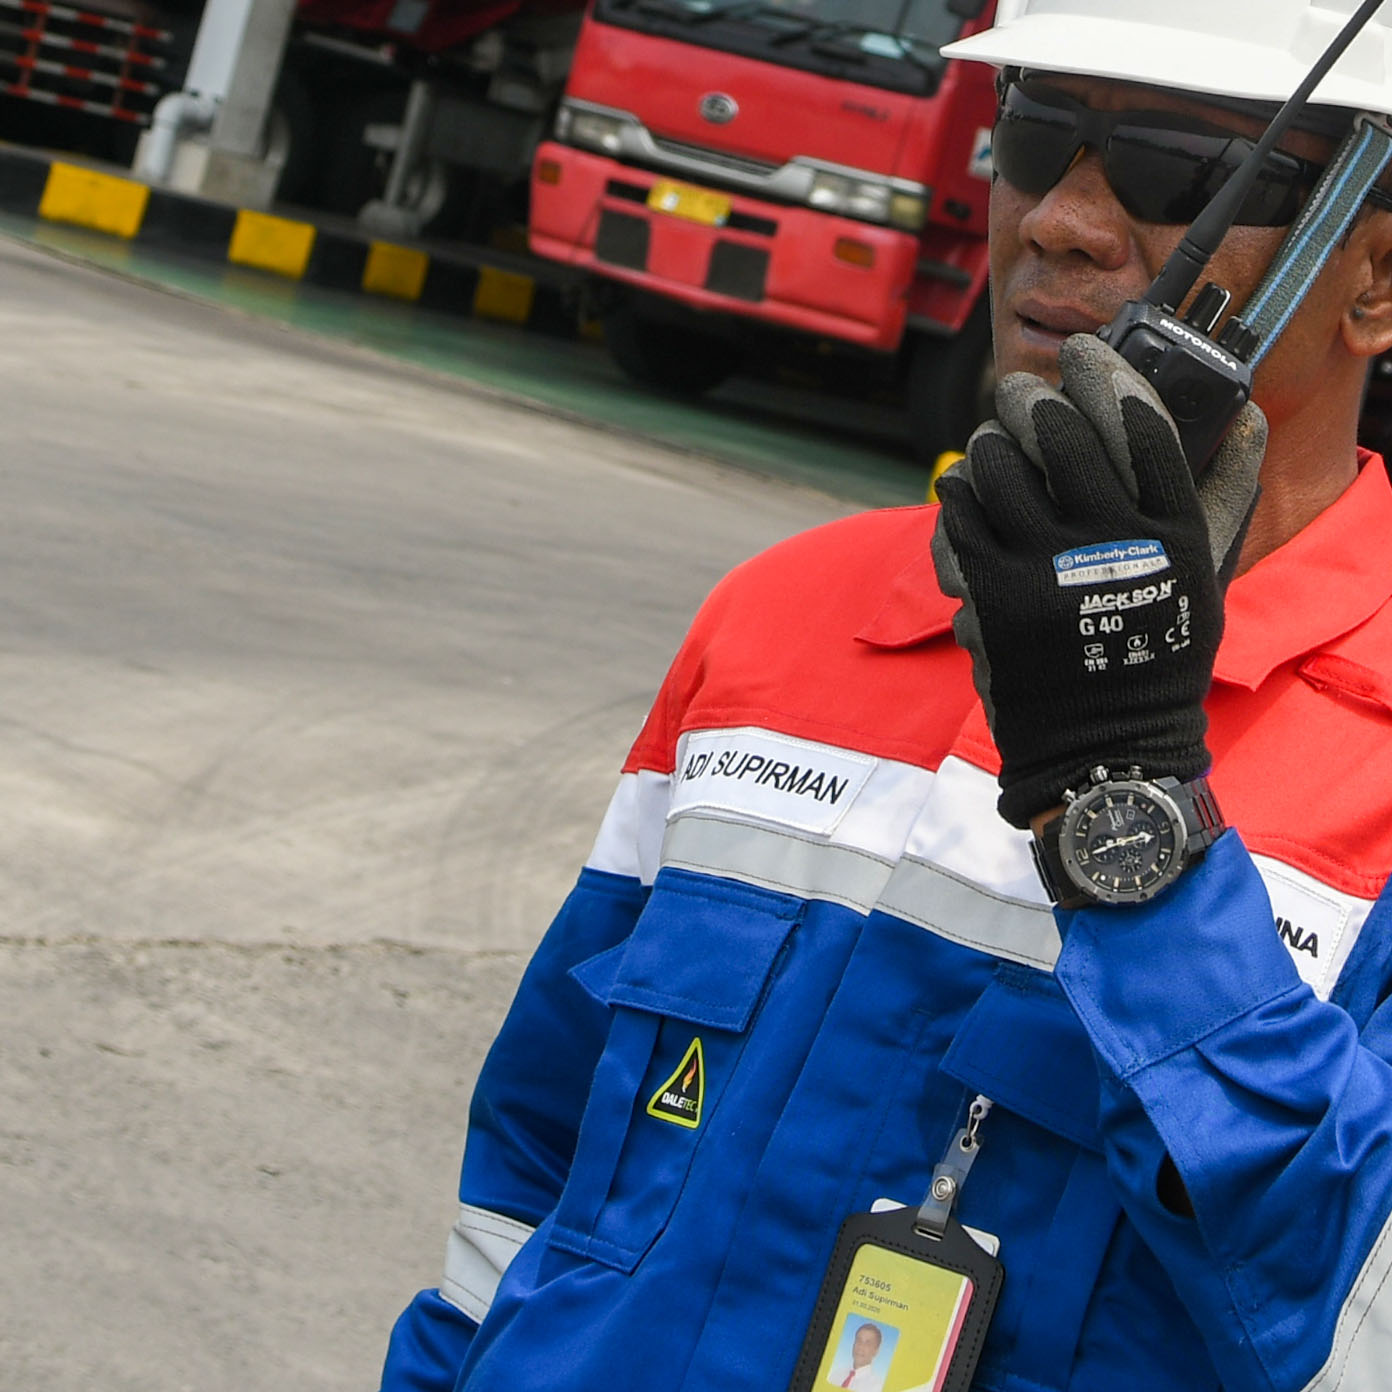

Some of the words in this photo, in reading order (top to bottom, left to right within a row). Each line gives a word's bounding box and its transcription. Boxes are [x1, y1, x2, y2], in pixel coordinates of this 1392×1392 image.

[1159, 319, 1237, 371] MOTOROLA
[1074, 544, 1159, 564] Kimberly-Clark
[1079, 579, 1176, 614] JACKSON
[1079, 617, 1095, 636] G
[1099, 615, 1124, 634] 40
[681, 751, 714, 783] ADI
[711, 750, 849, 805] SUPIRMAN
[852, 1286, 867, 1297] Adi
[868, 1291, 909, 1311] Supirman
